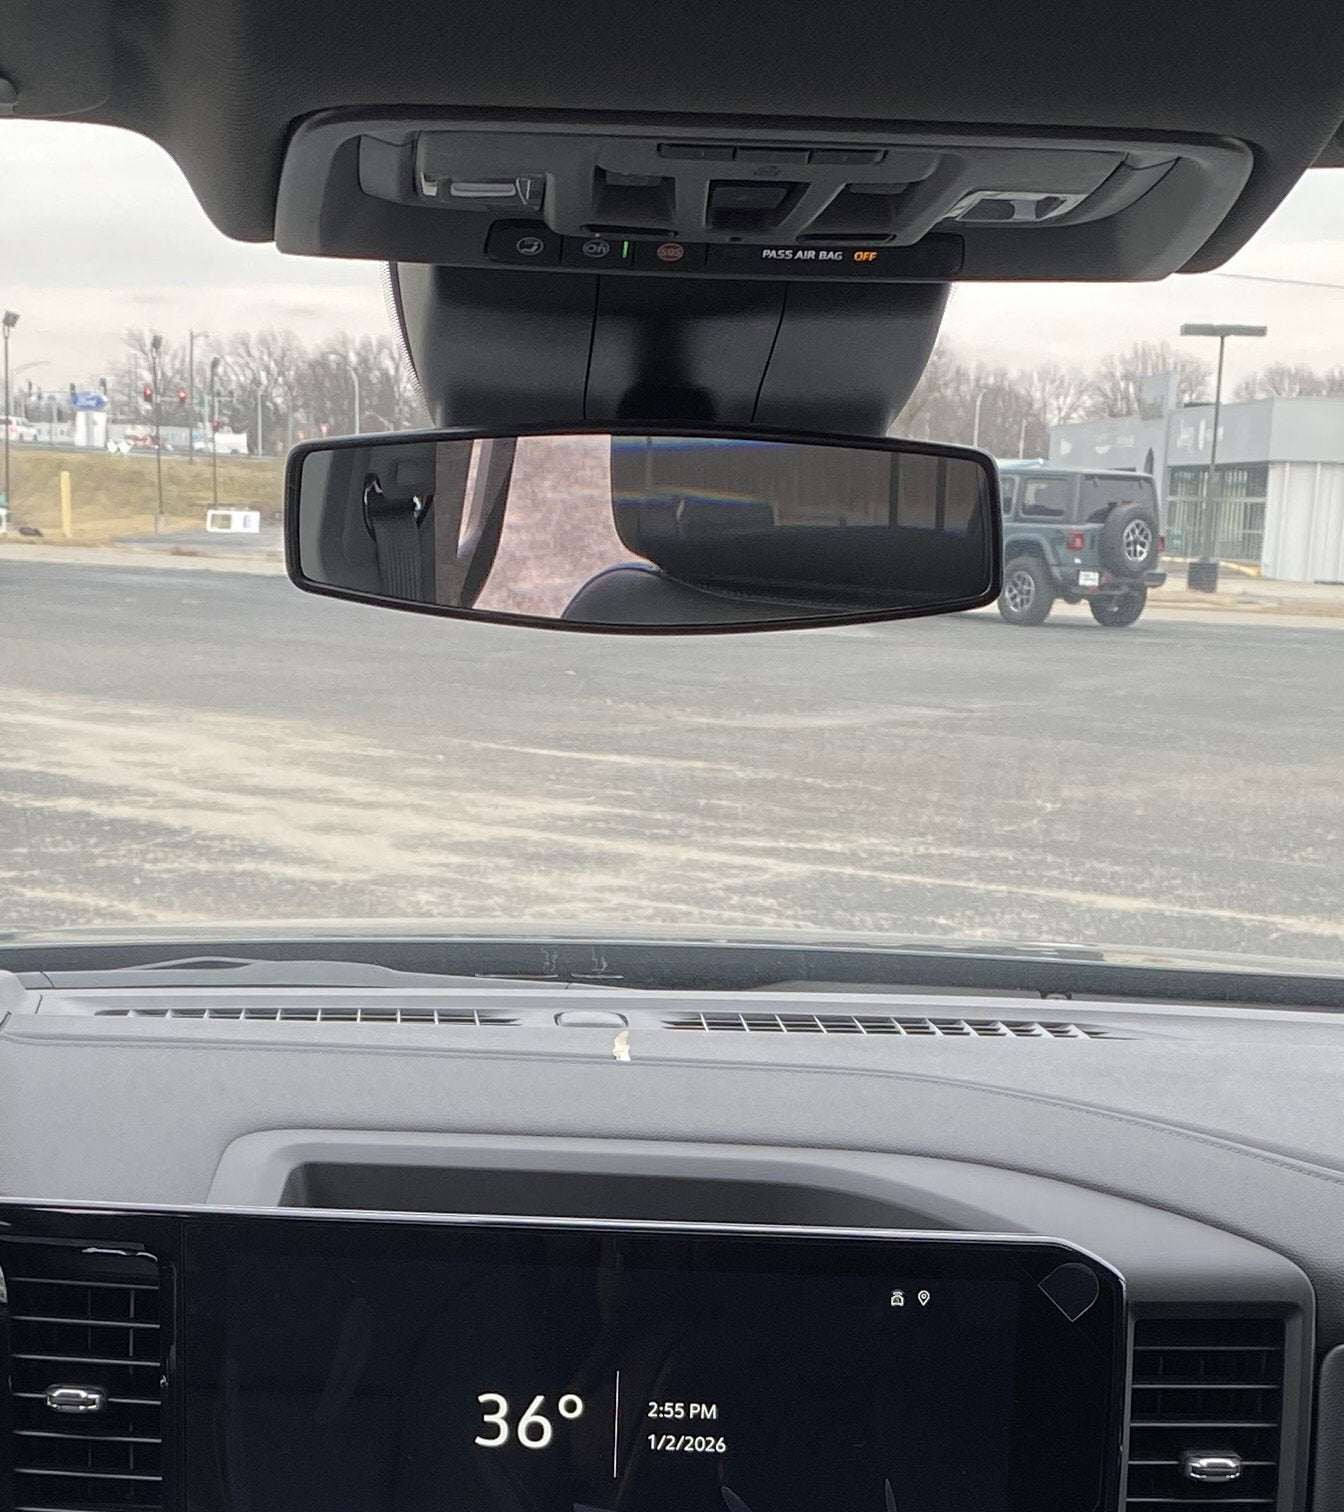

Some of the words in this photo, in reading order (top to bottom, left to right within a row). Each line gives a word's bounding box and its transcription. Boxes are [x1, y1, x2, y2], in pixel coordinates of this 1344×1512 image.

[762, 249, 793, 259] PASS
[794, 250, 816, 260] AIR
[818, 251, 843, 260] BAG
[854, 251, 878, 261] OFF
[647, 1401, 685, 1419] 2:55
[689, 1403, 718, 1420] PM
[648, 1434, 727, 1453] 1/2/2026
